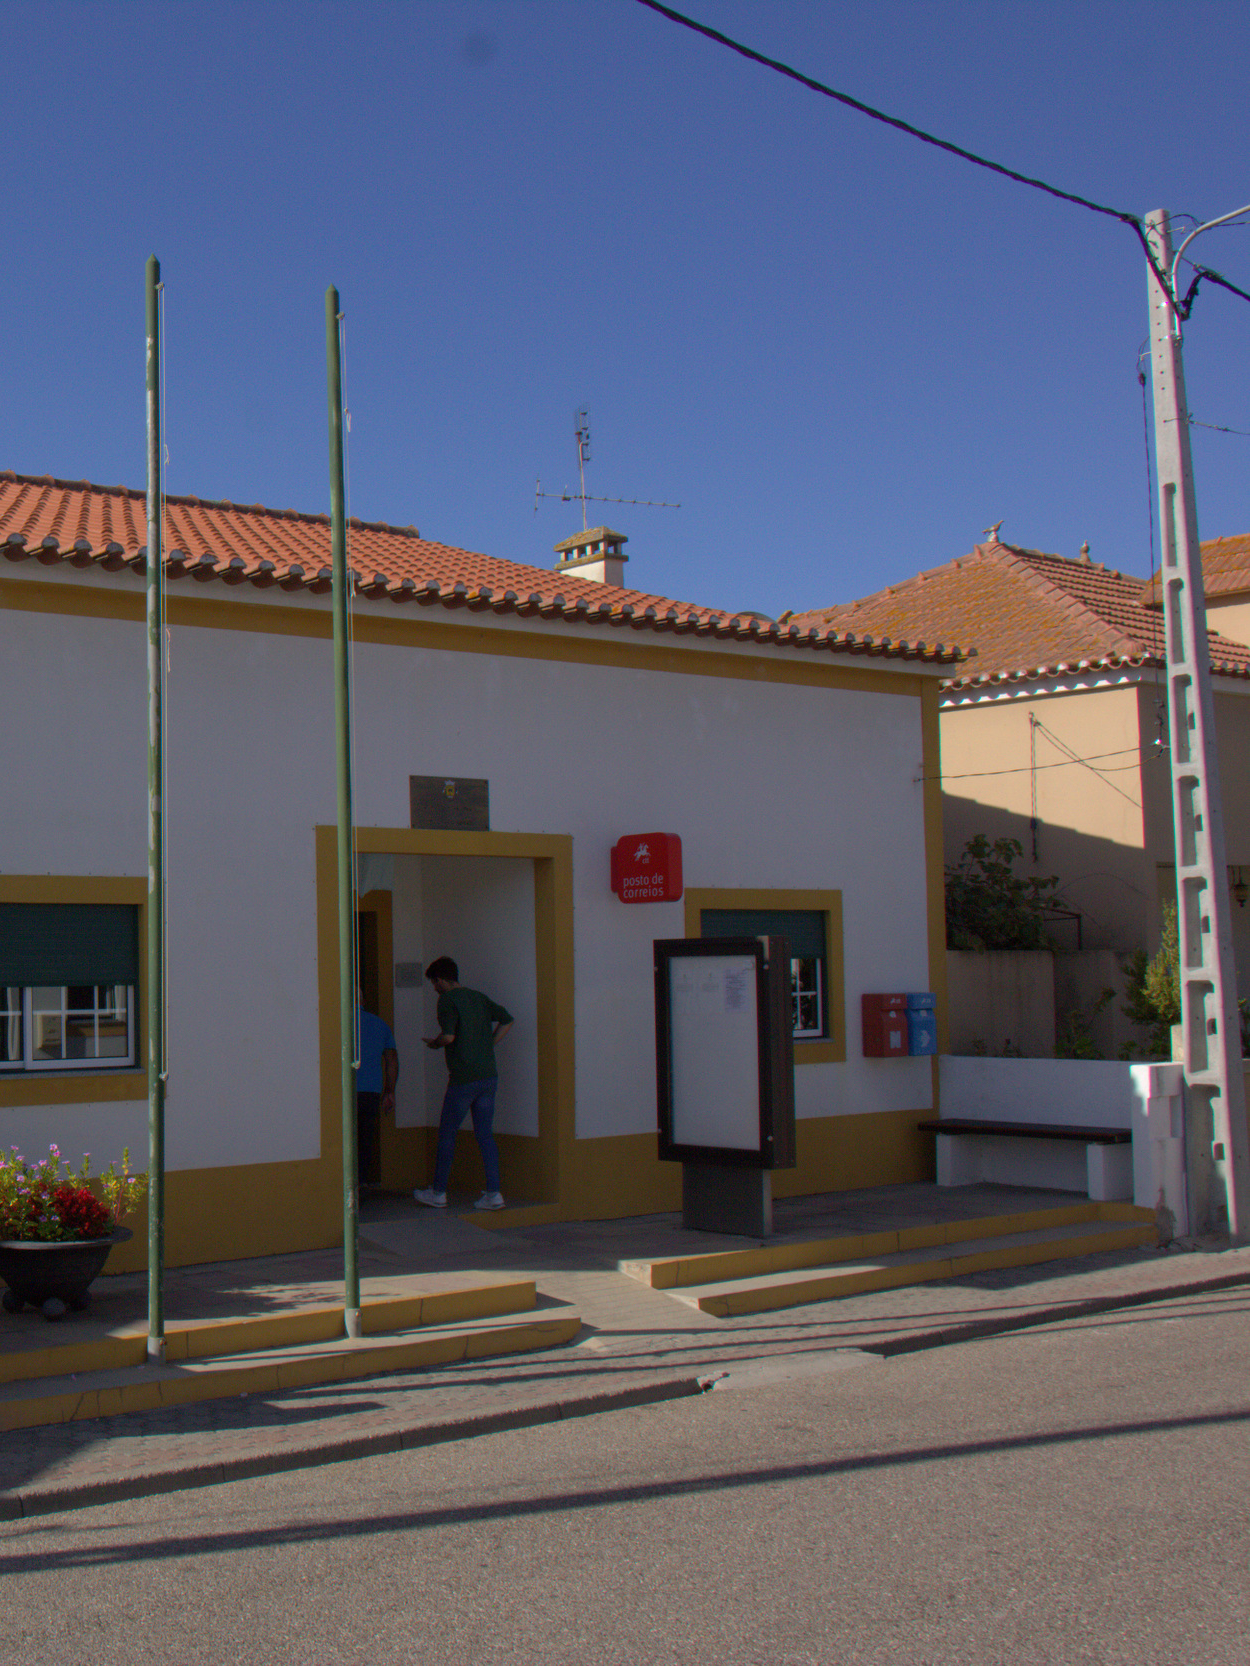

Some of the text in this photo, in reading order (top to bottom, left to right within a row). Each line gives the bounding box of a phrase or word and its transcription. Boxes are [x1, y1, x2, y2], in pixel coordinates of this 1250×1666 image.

[623, 873, 664, 888] posto de
[623, 886, 664, 898] correios
